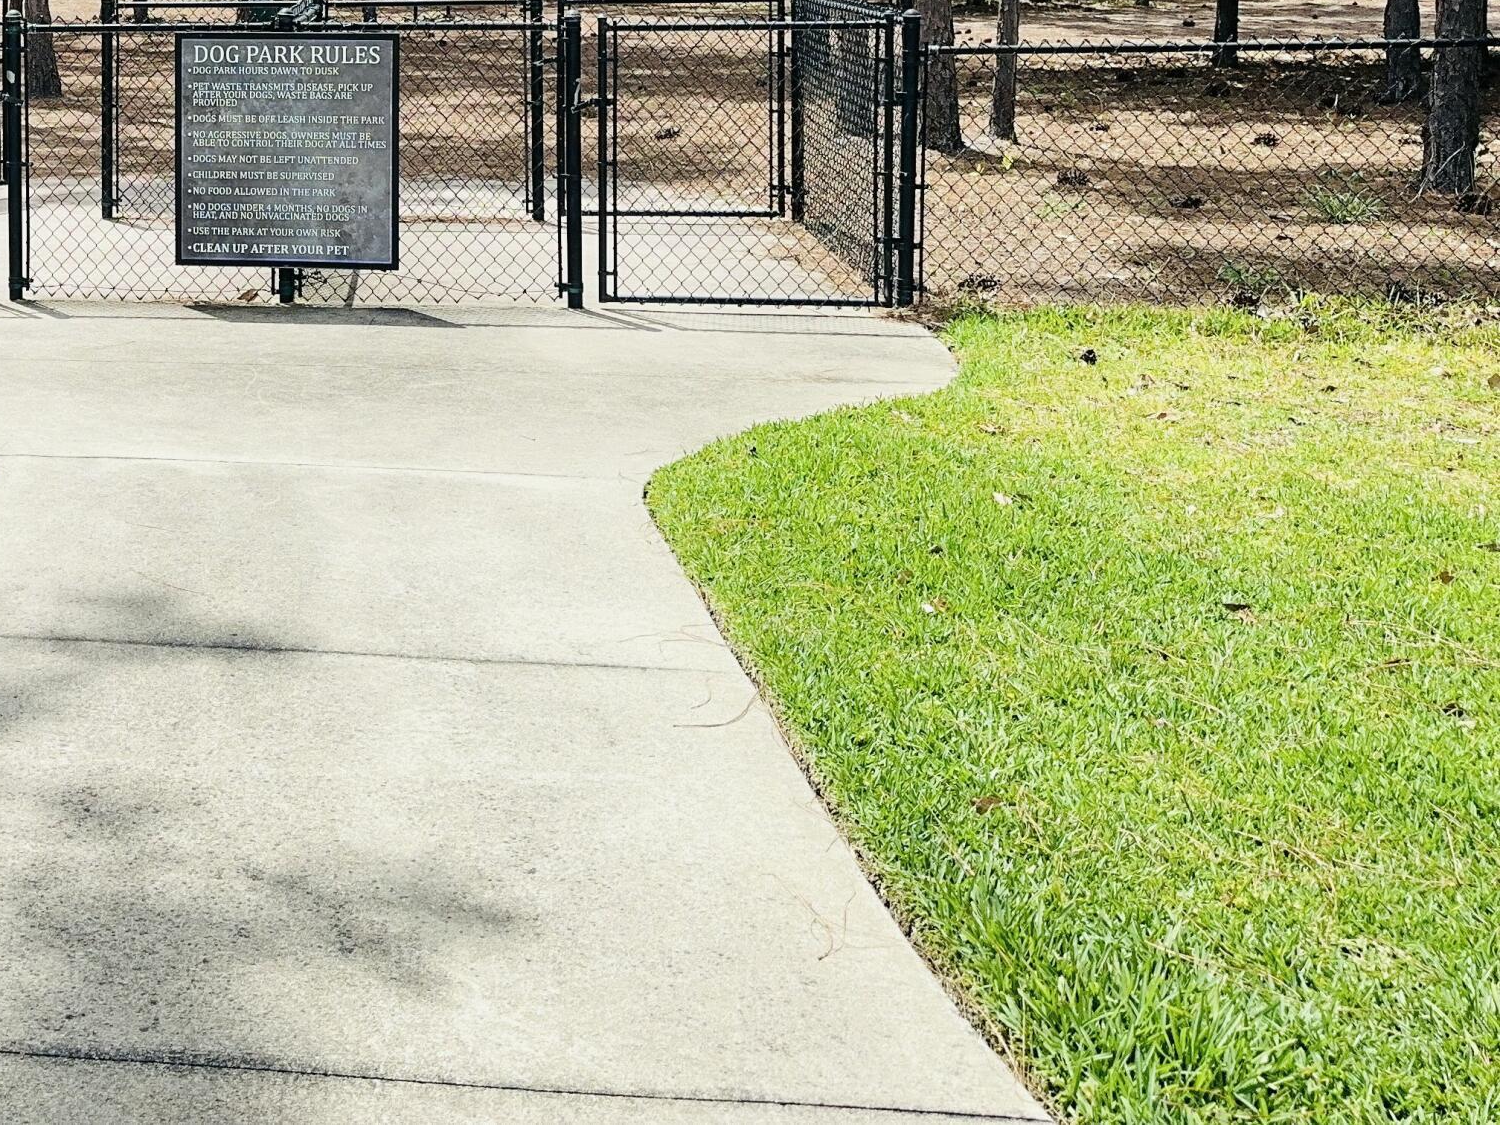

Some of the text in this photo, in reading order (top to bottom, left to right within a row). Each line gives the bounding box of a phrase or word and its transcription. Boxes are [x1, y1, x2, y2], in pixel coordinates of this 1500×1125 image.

[194, 44, 381, 65] DOG PARK RULES
[213, 67, 237, 75] PARK
[238, 67, 269, 75] HOURS
[271, 67, 299, 75] DAWN
[300, 67, 313, 75] TO
[315, 67, 339, 75] DUSK
[192, 82, 209, 91] PET
[211, 83, 242, 91] WASTE
[243, 83, 295, 91] TRANSMITS
[337, 84, 358, 92] PICK
[359, 84, 373, 92] UP
[192, 91, 222, 99] AFTER
[223, 91, 247, 99] YOUR
[277, 91, 308, 100] WASTE
[309, 92, 333, 100] BAGS
[334, 92, 353, 100] ARE
[192, 99, 237, 107] PROVIDED
[192, 115, 385, 125] DOGS MUST BE OFF LEASH INSIDE THE PARK
[192, 131, 206, 139] NO
[207, 131, 261, 139] AGGRESSIVE
[291, 132, 330, 140] OWNERS
[332, 132, 357, 141] MUST
[359, 132, 371, 141] BE
[192, 139, 387, 149] ABLE TO CONTROL THEIR DOG AT ALL TIMES
[192, 155, 359, 165] DOGS MAY NOT BE LEFT UNATTENDED
[192, 171, 335, 181] CHILDREN MUST BE SUPERVISED
[192, 187, 336, 197] NO FOOD ALLOWED IN THE PARK
[192, 203, 206, 211] NO
[208, 203, 232, 211] DOGS
[233, 204, 264, 212] UNDER
[266, 204, 272, 212] 4
[316, 205, 330, 213] NO
[331, 205, 356, 214] DOGS
[357, 205, 368, 214] IN
[219, 211, 238, 220] AND
[239, 212, 254, 220] NO
[255, 212, 324, 221] UNVACCINATED
[325, 213, 350, 222] DOGS
[192, 227, 341, 238] USE THE PARK AT YOUR OWN RISK
[192, 243, 349, 256] CLEAN UP AFTER YOUR PET
